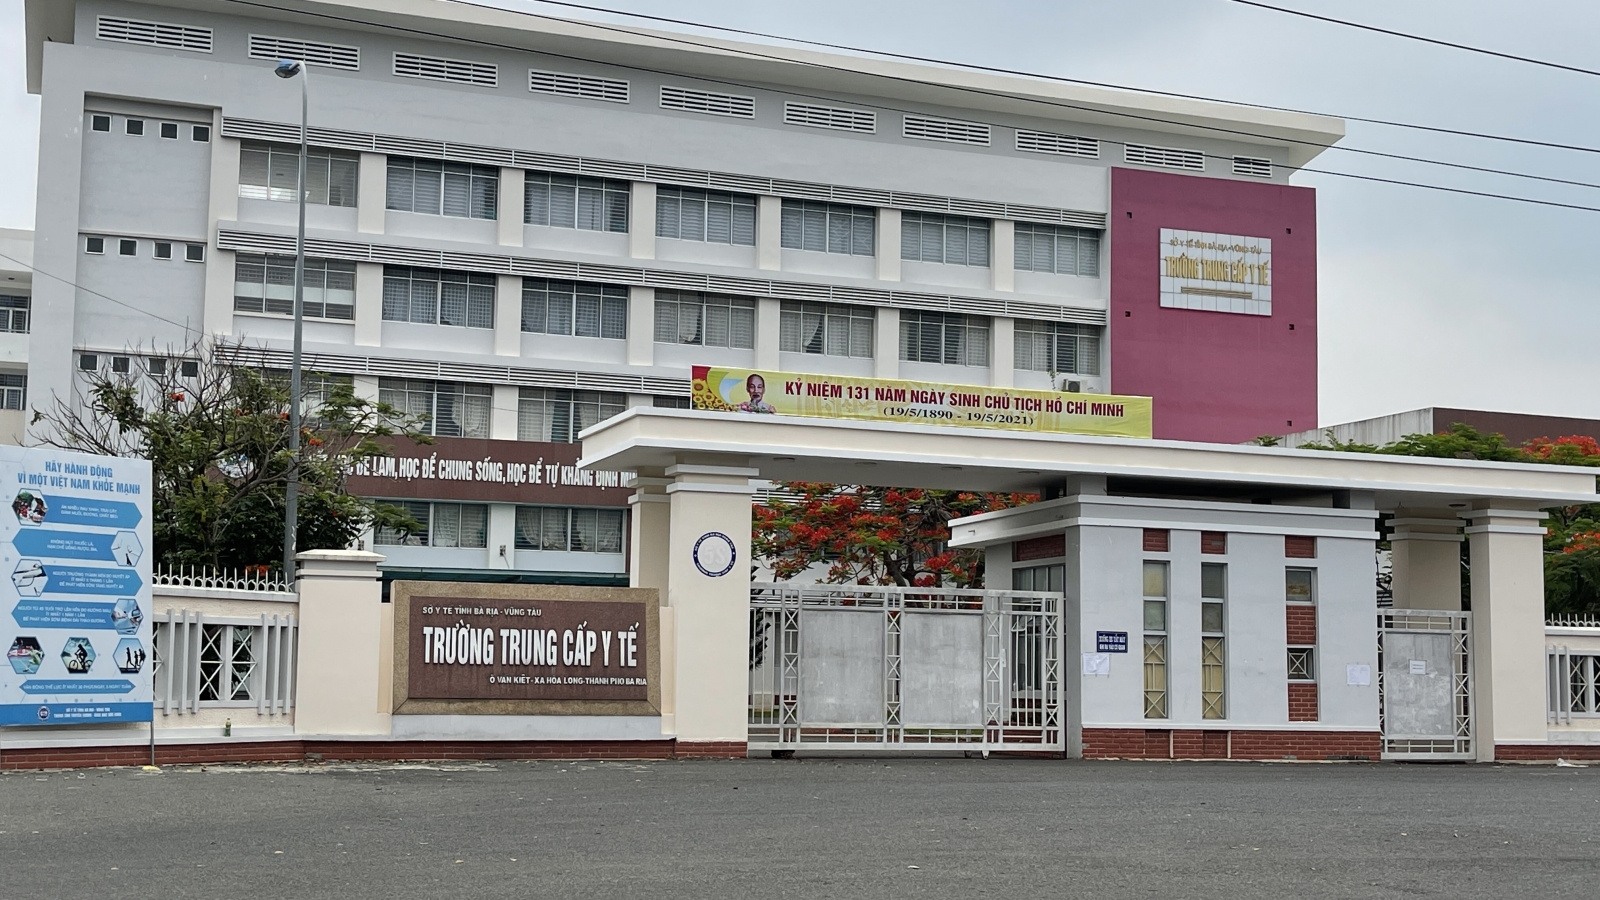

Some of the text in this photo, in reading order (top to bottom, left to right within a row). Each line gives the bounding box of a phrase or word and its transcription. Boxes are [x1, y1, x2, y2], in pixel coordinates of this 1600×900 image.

[1201, 258, 1229, 282] TRUNG
[1230, 256, 1248, 283] CẤP
[1250, 264, 1255, 284] Y
[1258, 260, 1269, 286] TẾ
[807, 381, 842, 400] NIỆM
[847, 386, 869, 400] 131
[875, 385, 906, 402] NĂM
[910, 388, 945, 405] NGÀY
[950, 392, 980, 407] SINH
[984, 392, 1010, 410] CHỦ
[1014, 397, 1042, 414] TỊCH
[1066, 400, 1087, 415] CHÍ
[1091, 403, 1124, 417] MINH
[883, 407, 953, 420] (19/5/1890
[967, 412, 1034, 426] 19/5/2021)
[18, 470, 26, 484] VÌ
[29, 472, 47, 487] MỘT
[50, 475, 68, 489] VIỆT
[70, 478, 90, 490] NAM
[116, 483, 141, 495] MẠNH
[45, 461, 113, 479] HÃY HÀNH ĐỘNG
[400, 458, 420, 481] HỌC
[422, 451, 437, 479] ĐỂ
[438, 459, 472, 480] CHUNG
[475, 456, 506, 485] SỐNG,
[507, 463, 526, 486] HỌC
[528, 457, 543, 484] ĐỂ
[545, 462, 560, 488] TỰ
[474, 606, 484, 615] BÀ
[486, 608, 499, 617] RỊA
[504, 606, 525, 616] VŨNG
[527, 607, 542, 616] TÀU
[423, 619, 640, 667] TRƯỜNG TRUNG CẤP Y TẾ
